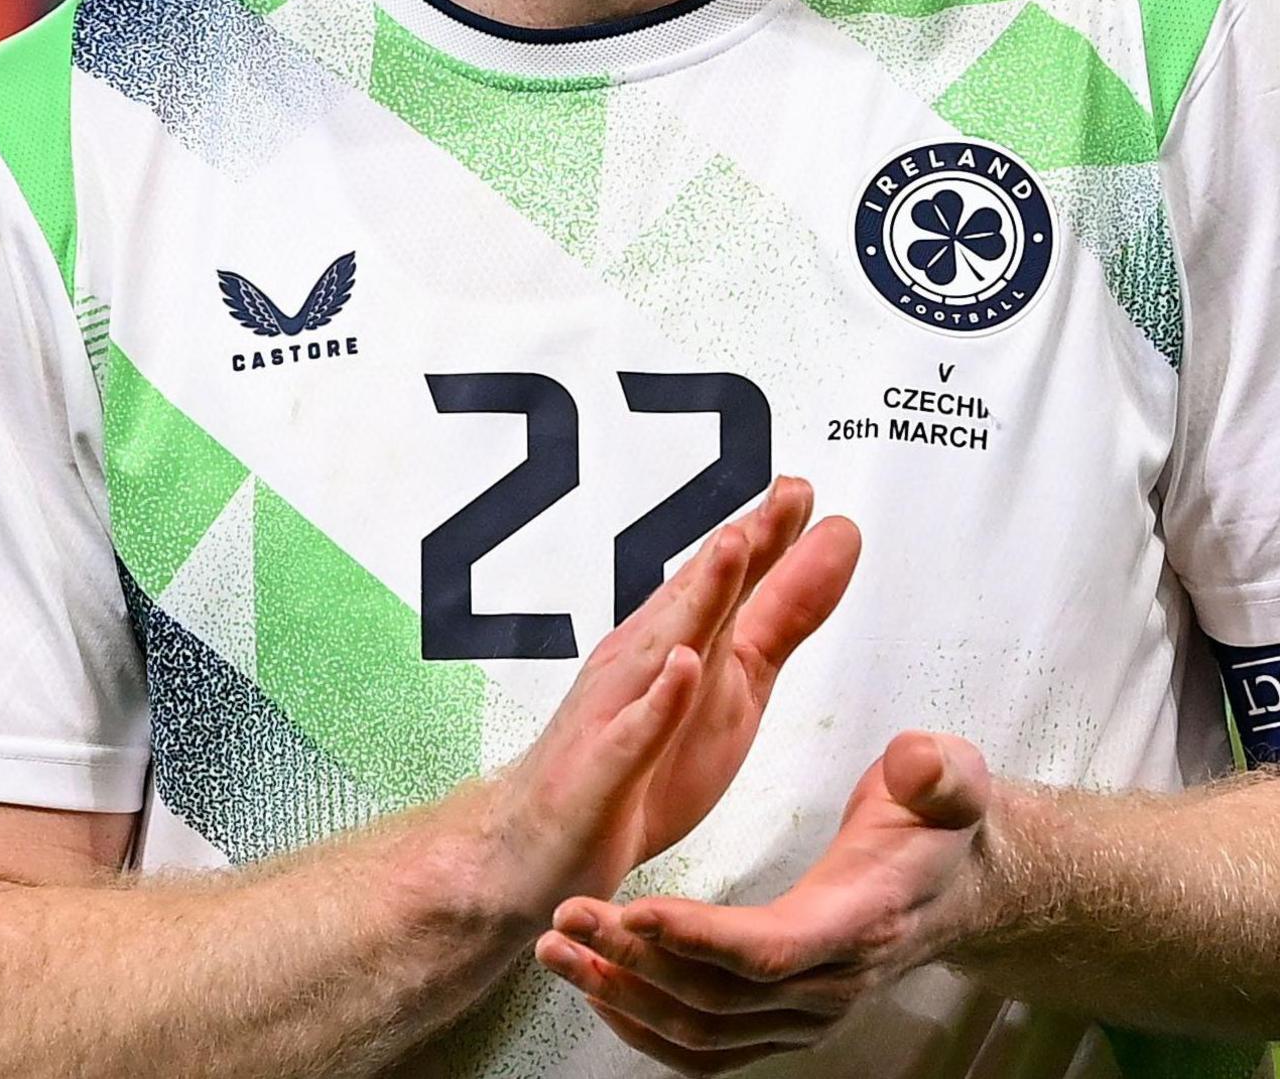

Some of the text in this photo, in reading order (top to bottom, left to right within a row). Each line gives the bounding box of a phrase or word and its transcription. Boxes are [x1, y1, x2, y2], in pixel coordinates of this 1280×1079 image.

[865, 148, 1033, 213] IRELAND
[900, 290, 1025, 324] FOOTBALL
[232, 337, 358, 372] CASTORE
[827, 418, 988, 451] 26th MARCH
[421, 372, 772, 660] 22
